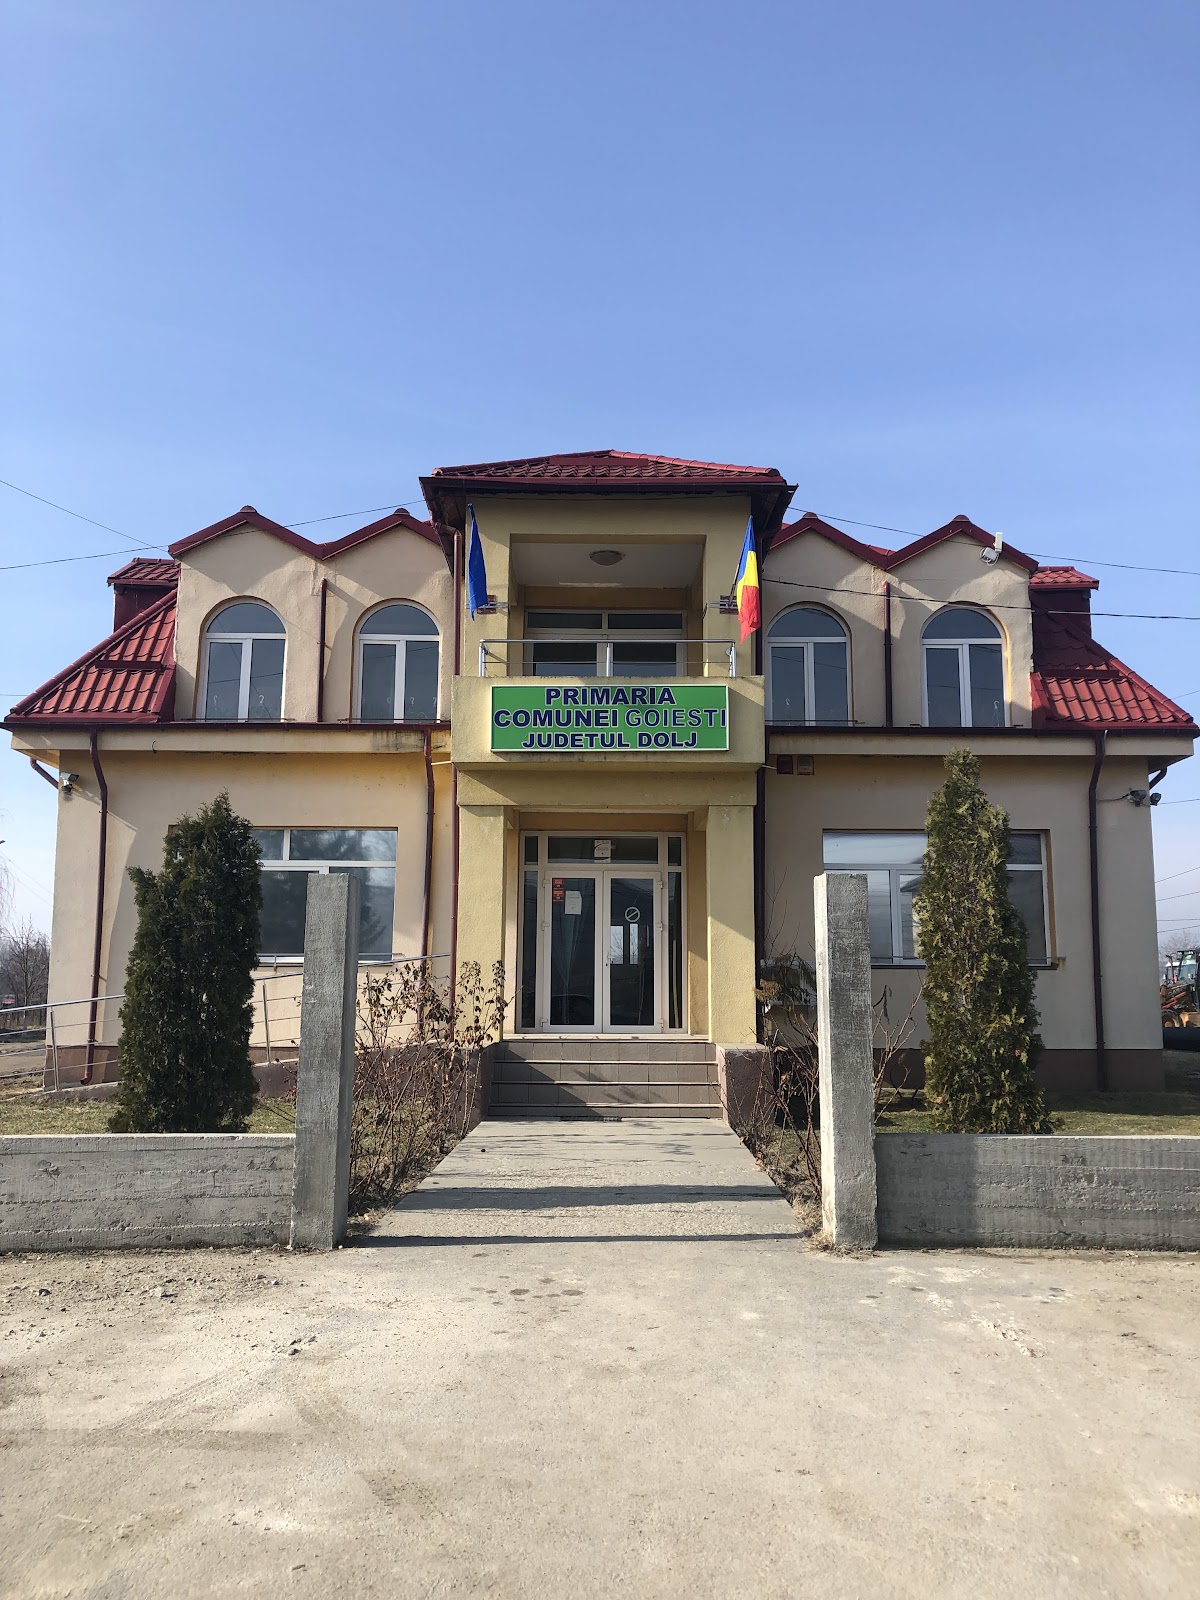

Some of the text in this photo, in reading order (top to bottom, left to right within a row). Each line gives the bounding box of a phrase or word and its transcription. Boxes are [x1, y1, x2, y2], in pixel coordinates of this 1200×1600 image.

[545, 687, 676, 706] PRIMARIA
[493, 709, 726, 728] COMUNEI GOIESTI
[522, 732, 698, 749] JUDETUL DOLJ
